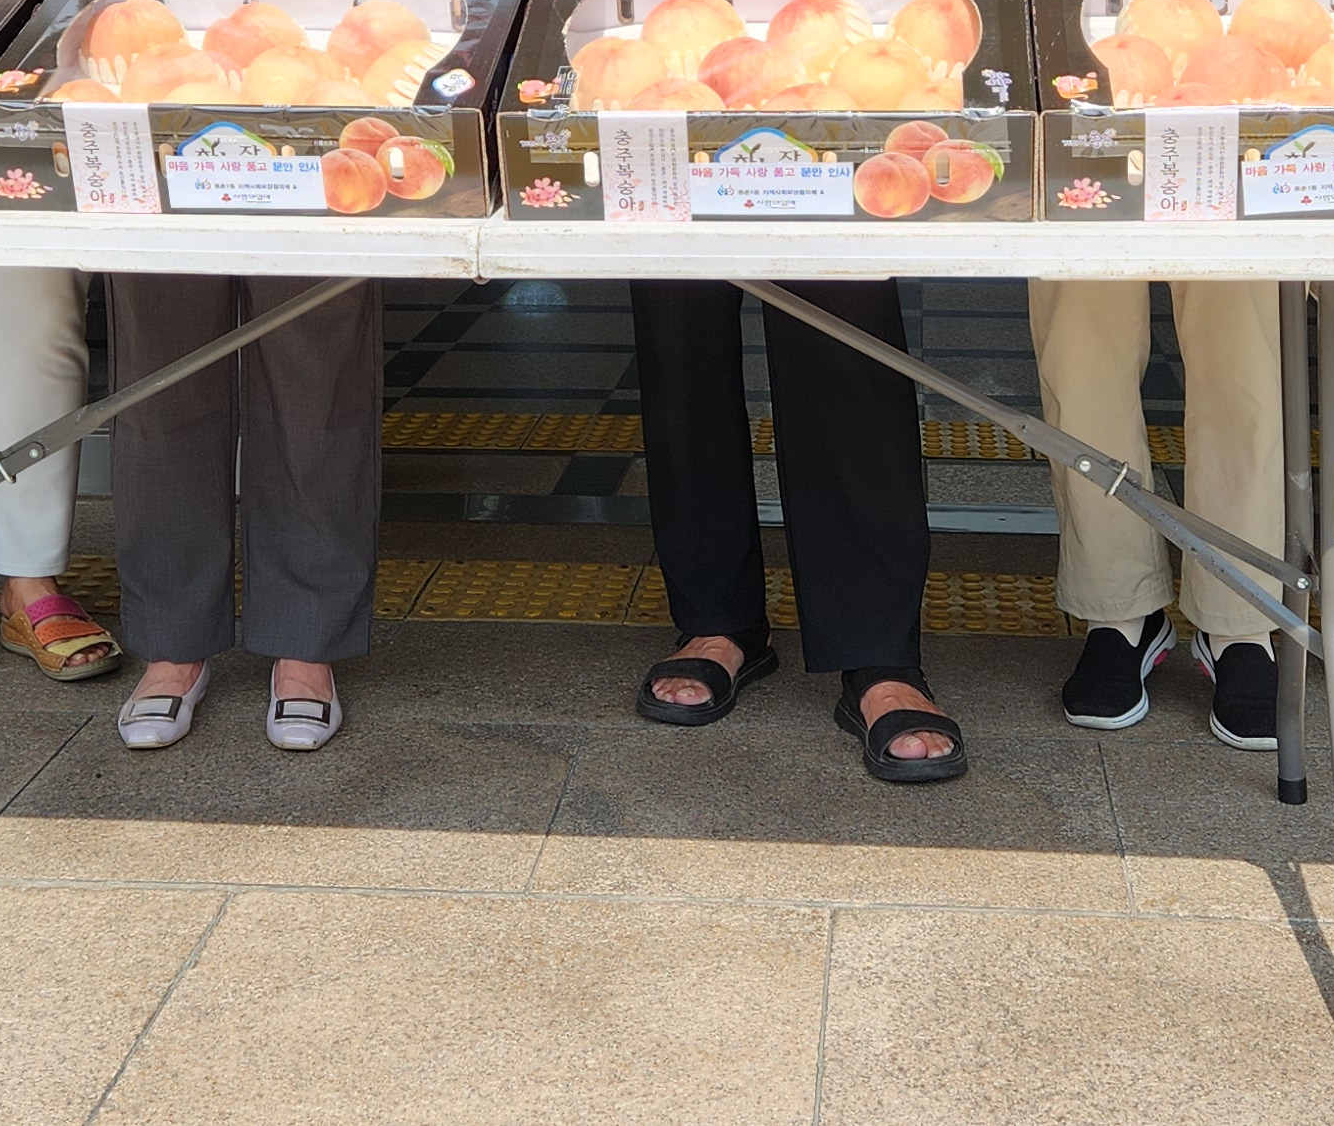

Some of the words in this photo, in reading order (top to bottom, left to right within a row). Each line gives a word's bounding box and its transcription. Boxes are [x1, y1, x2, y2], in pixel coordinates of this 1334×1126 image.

[79, 122, 107, 205] 충주복숭아
[168, 161, 189, 172] 마음
[194, 161, 215, 172] 가득
[220, 161, 241, 172] 사랑
[246, 161, 268, 172] 품고
[272, 162, 293, 172] 문안
[298, 161, 319, 172] 인사
[613, 129, 637, 212] 충주복숭아
[1159, 126, 1179, 212] 충주복숭아
[1245, 166, 1268, 178] 마음
[1274, 163, 1296, 175] 가득
[1303, 162, 1326, 173] 사랑
